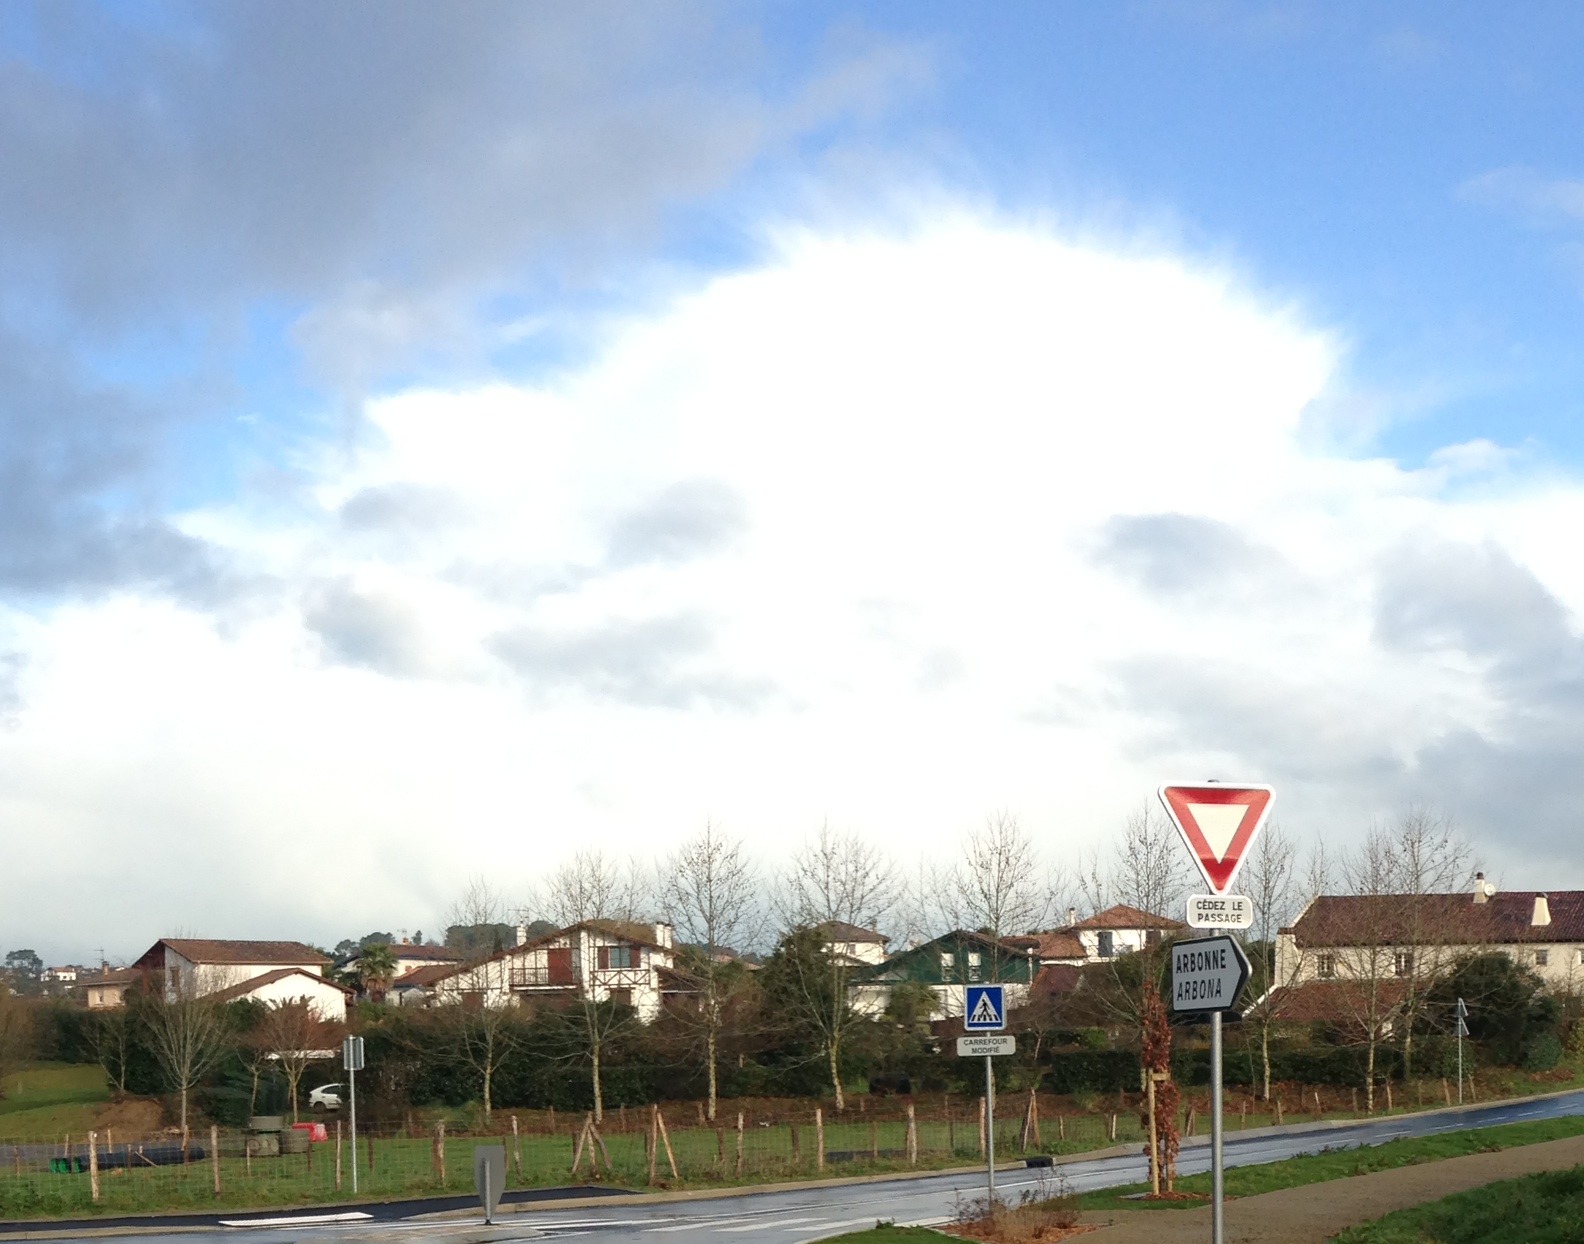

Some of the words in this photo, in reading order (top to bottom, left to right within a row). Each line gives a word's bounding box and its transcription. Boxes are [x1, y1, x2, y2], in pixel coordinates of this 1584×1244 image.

[1196, 899, 1225, 910] CÉDEZ
[1232, 901, 1243, 911] LE
[1197, 913, 1242, 923] PASSAGE
[1176, 949, 1226, 974] ARBONNE
[1177, 978, 1222, 1001] ARBONA
[963, 1038, 1008, 1046] CARREFOUR
[971, 1046, 1000, 1054] MODIFIÉ
